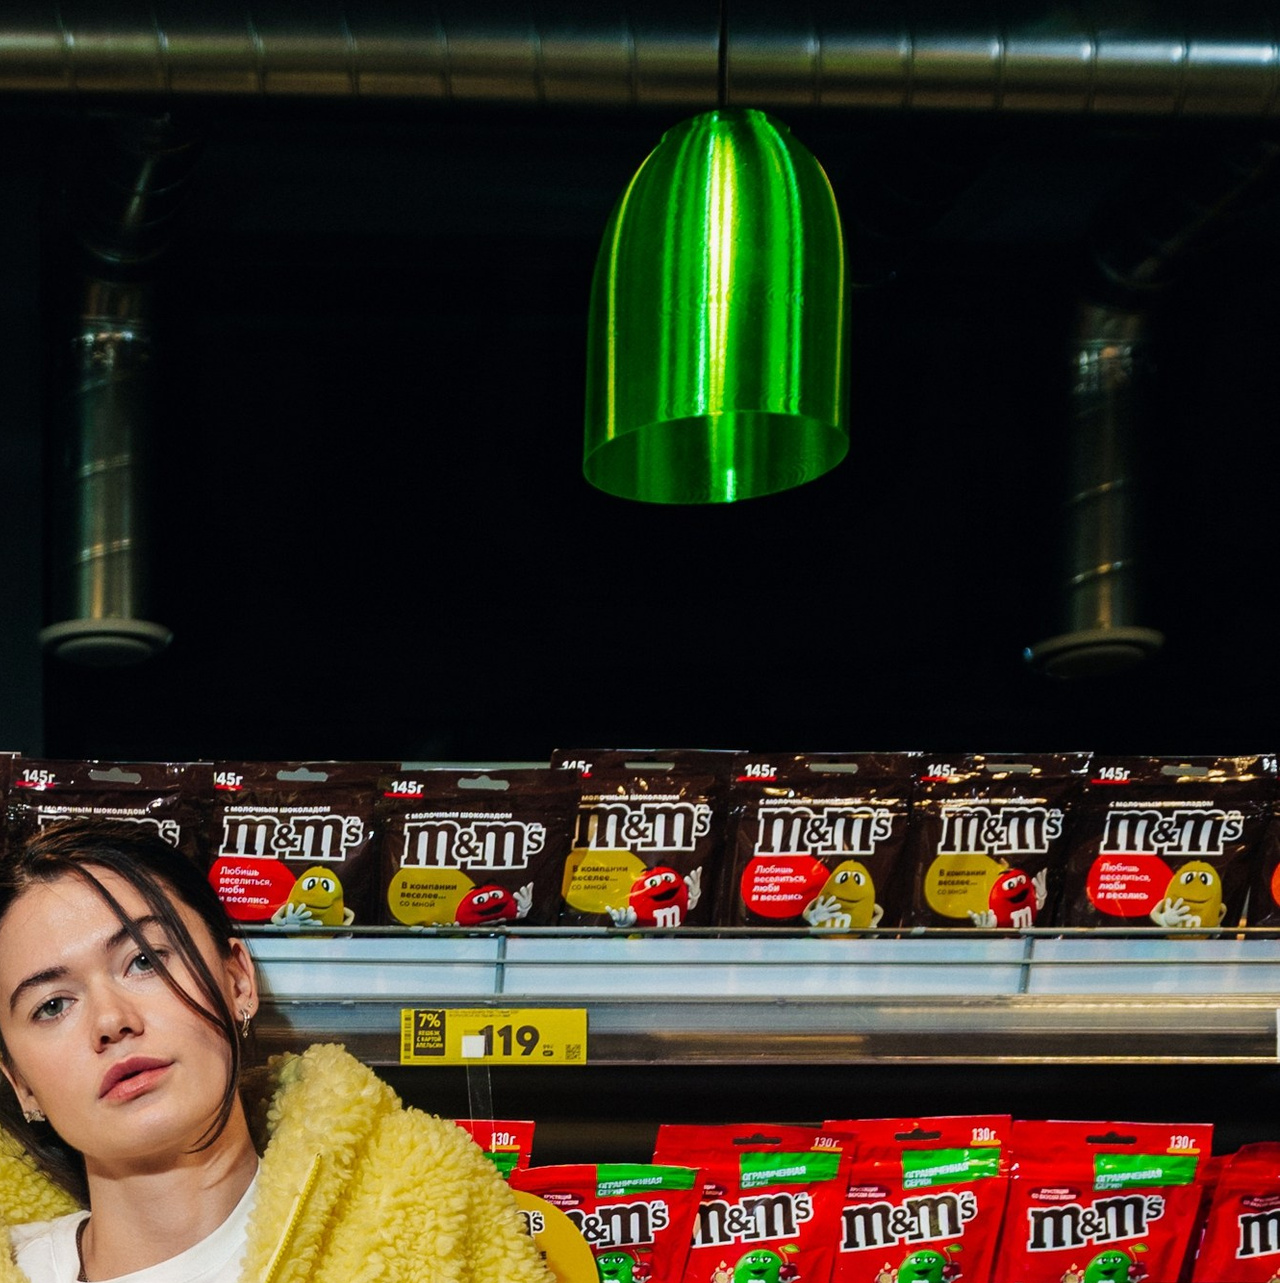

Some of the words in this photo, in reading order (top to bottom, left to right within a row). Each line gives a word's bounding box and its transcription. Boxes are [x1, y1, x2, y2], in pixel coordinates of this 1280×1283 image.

[23, 769, 56, 784] 145г
[745, 765, 776, 777] 145г
[1099, 767, 1130, 780] 145г
[392, 781, 423, 794] 145г
[419, 1014, 441, 1027] 7%
[478, 1025, 540, 1056] 119
[491, 1132, 516, 1147] 130г
[971, 1128, 997, 1142] 130г
[1169, 1135, 1196, 1149] 130г
[814, 1136, 838, 1149] 130г
[840, 1192, 977, 1252] m&m's
[1028, 1195, 1164, 1252] m&m's
